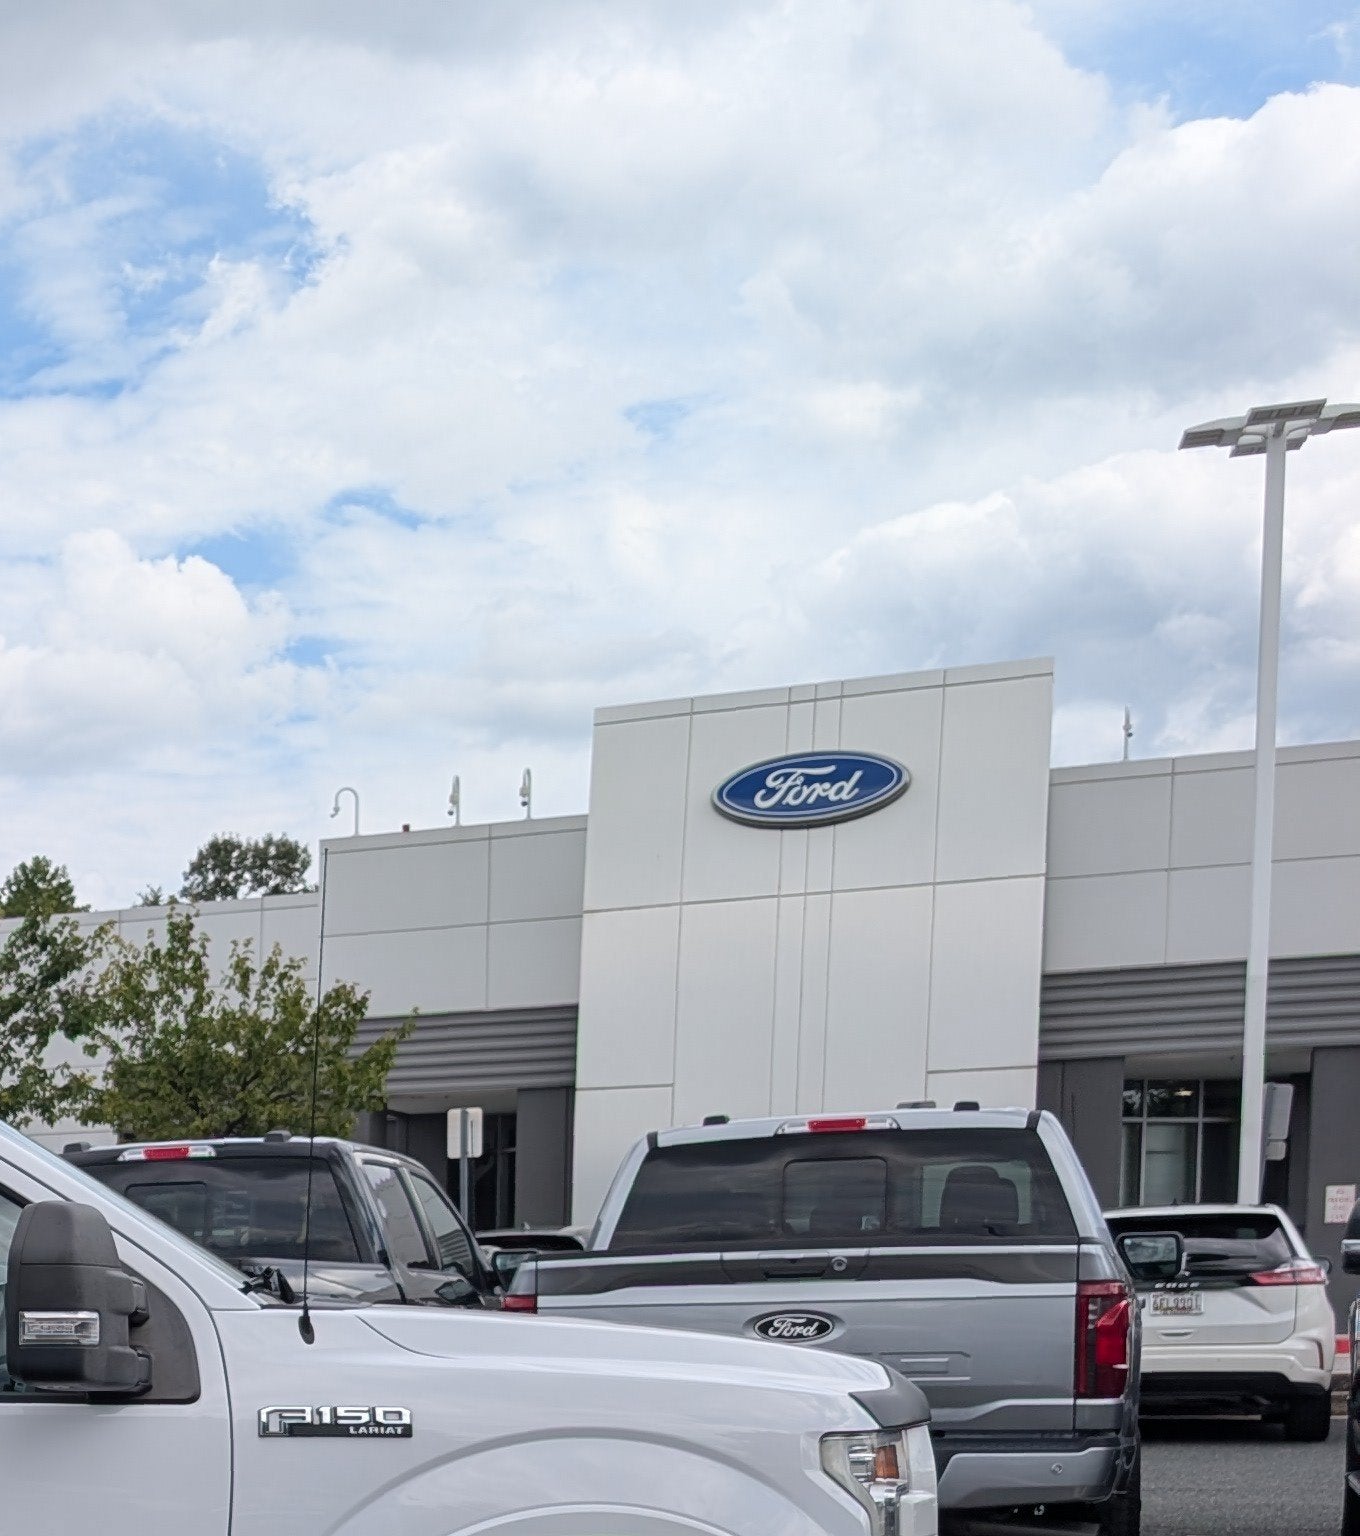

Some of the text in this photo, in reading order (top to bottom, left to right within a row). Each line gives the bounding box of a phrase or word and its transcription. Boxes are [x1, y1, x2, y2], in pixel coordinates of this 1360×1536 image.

[754, 764, 864, 809] Ford
[768, 1318, 820, 1337] Ford
[349, 1425, 404, 1434] LARIAT
